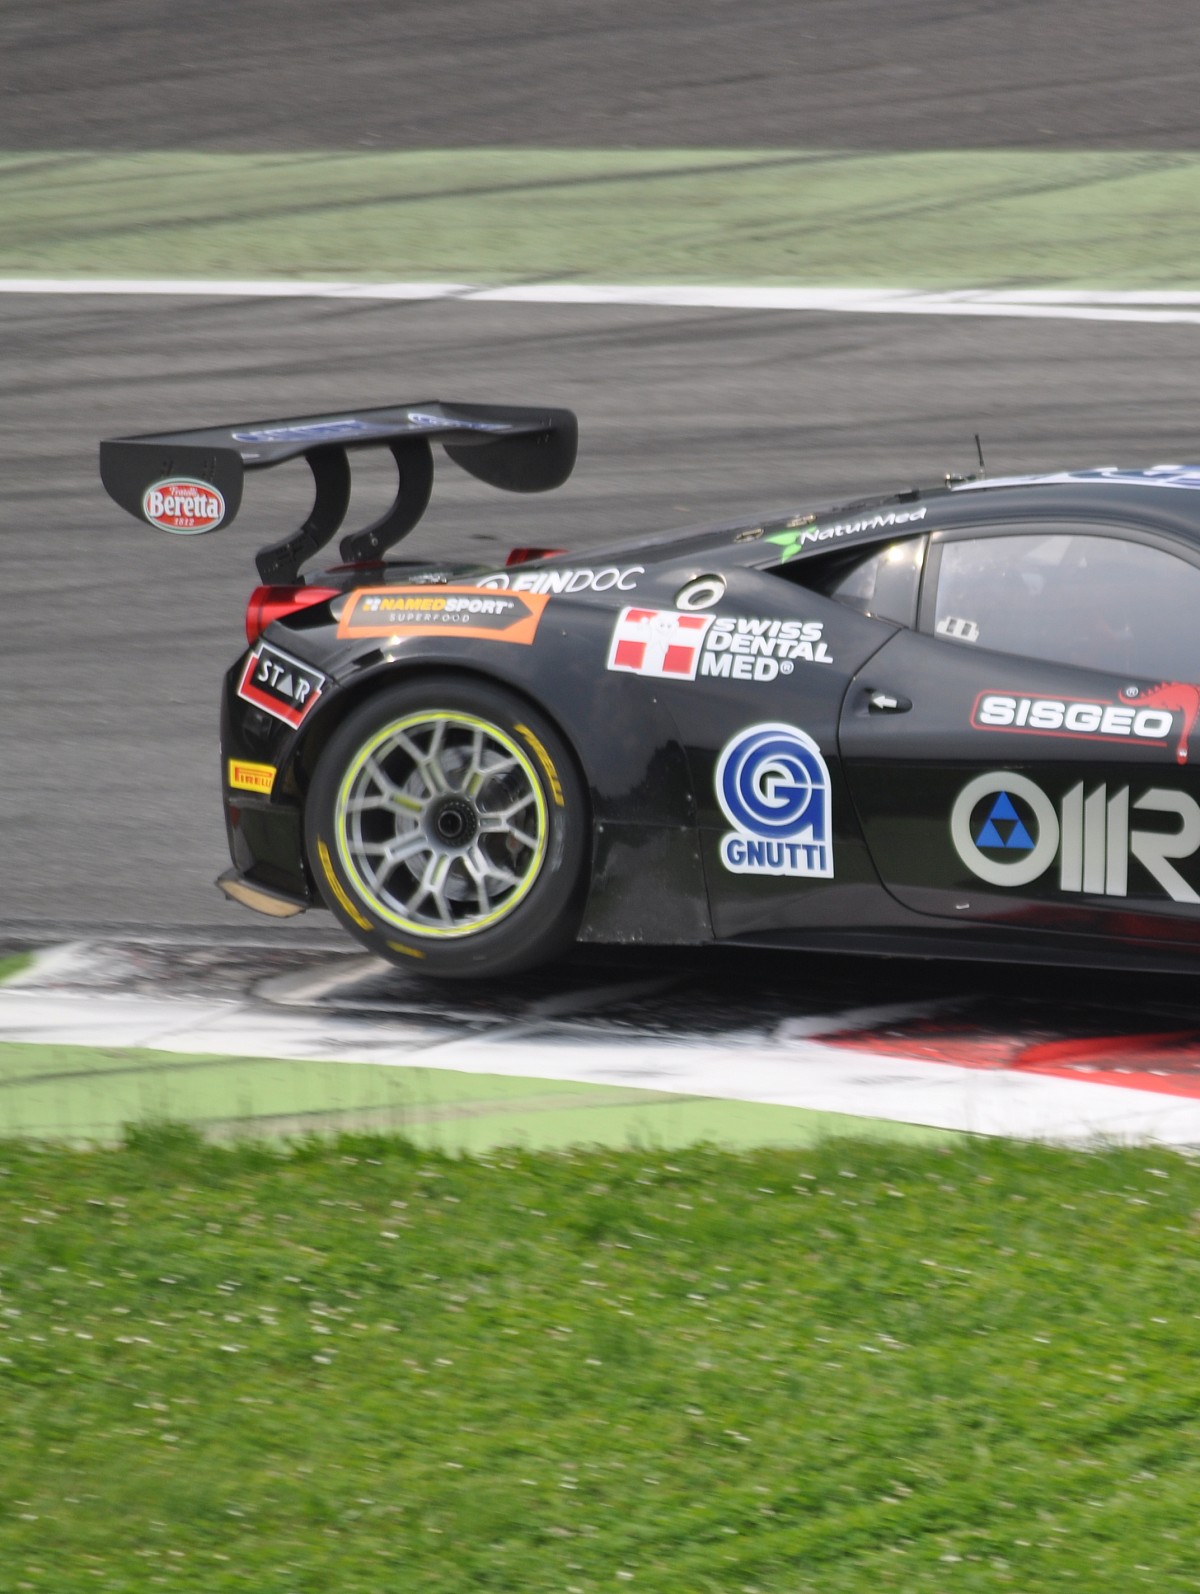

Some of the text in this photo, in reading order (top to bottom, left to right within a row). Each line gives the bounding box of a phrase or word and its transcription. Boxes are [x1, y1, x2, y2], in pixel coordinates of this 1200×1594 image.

[149, 491, 219, 518] Beretta
[801, 507, 927, 544] NaturMed
[512, 567, 645, 594] FINDOC
[389, 612, 470, 623] SUPERFOOD
[712, 618, 823, 642] SWISS
[706, 631, 833, 664] DENTAL
[980, 696, 1173, 738] SISGEO
[727, 839, 826, 871] GNUTTI
